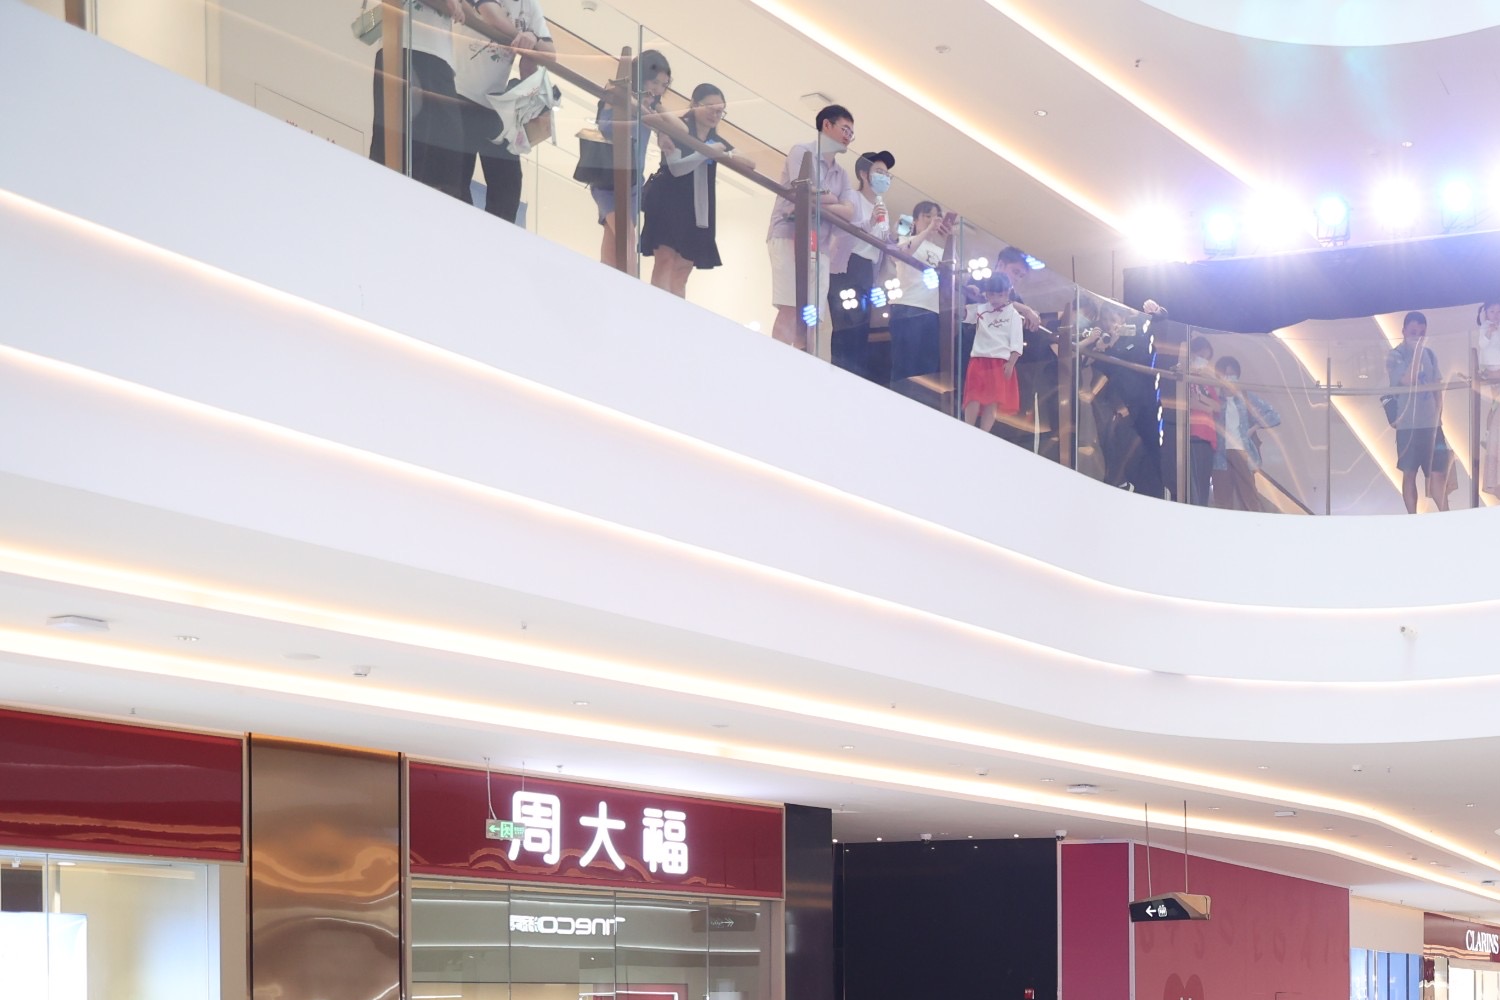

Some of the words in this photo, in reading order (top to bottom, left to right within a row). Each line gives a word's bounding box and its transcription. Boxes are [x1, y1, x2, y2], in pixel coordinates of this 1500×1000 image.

[507, 790, 689, 875] 周大福
[1466, 929, 1499, 954] CLARINS
